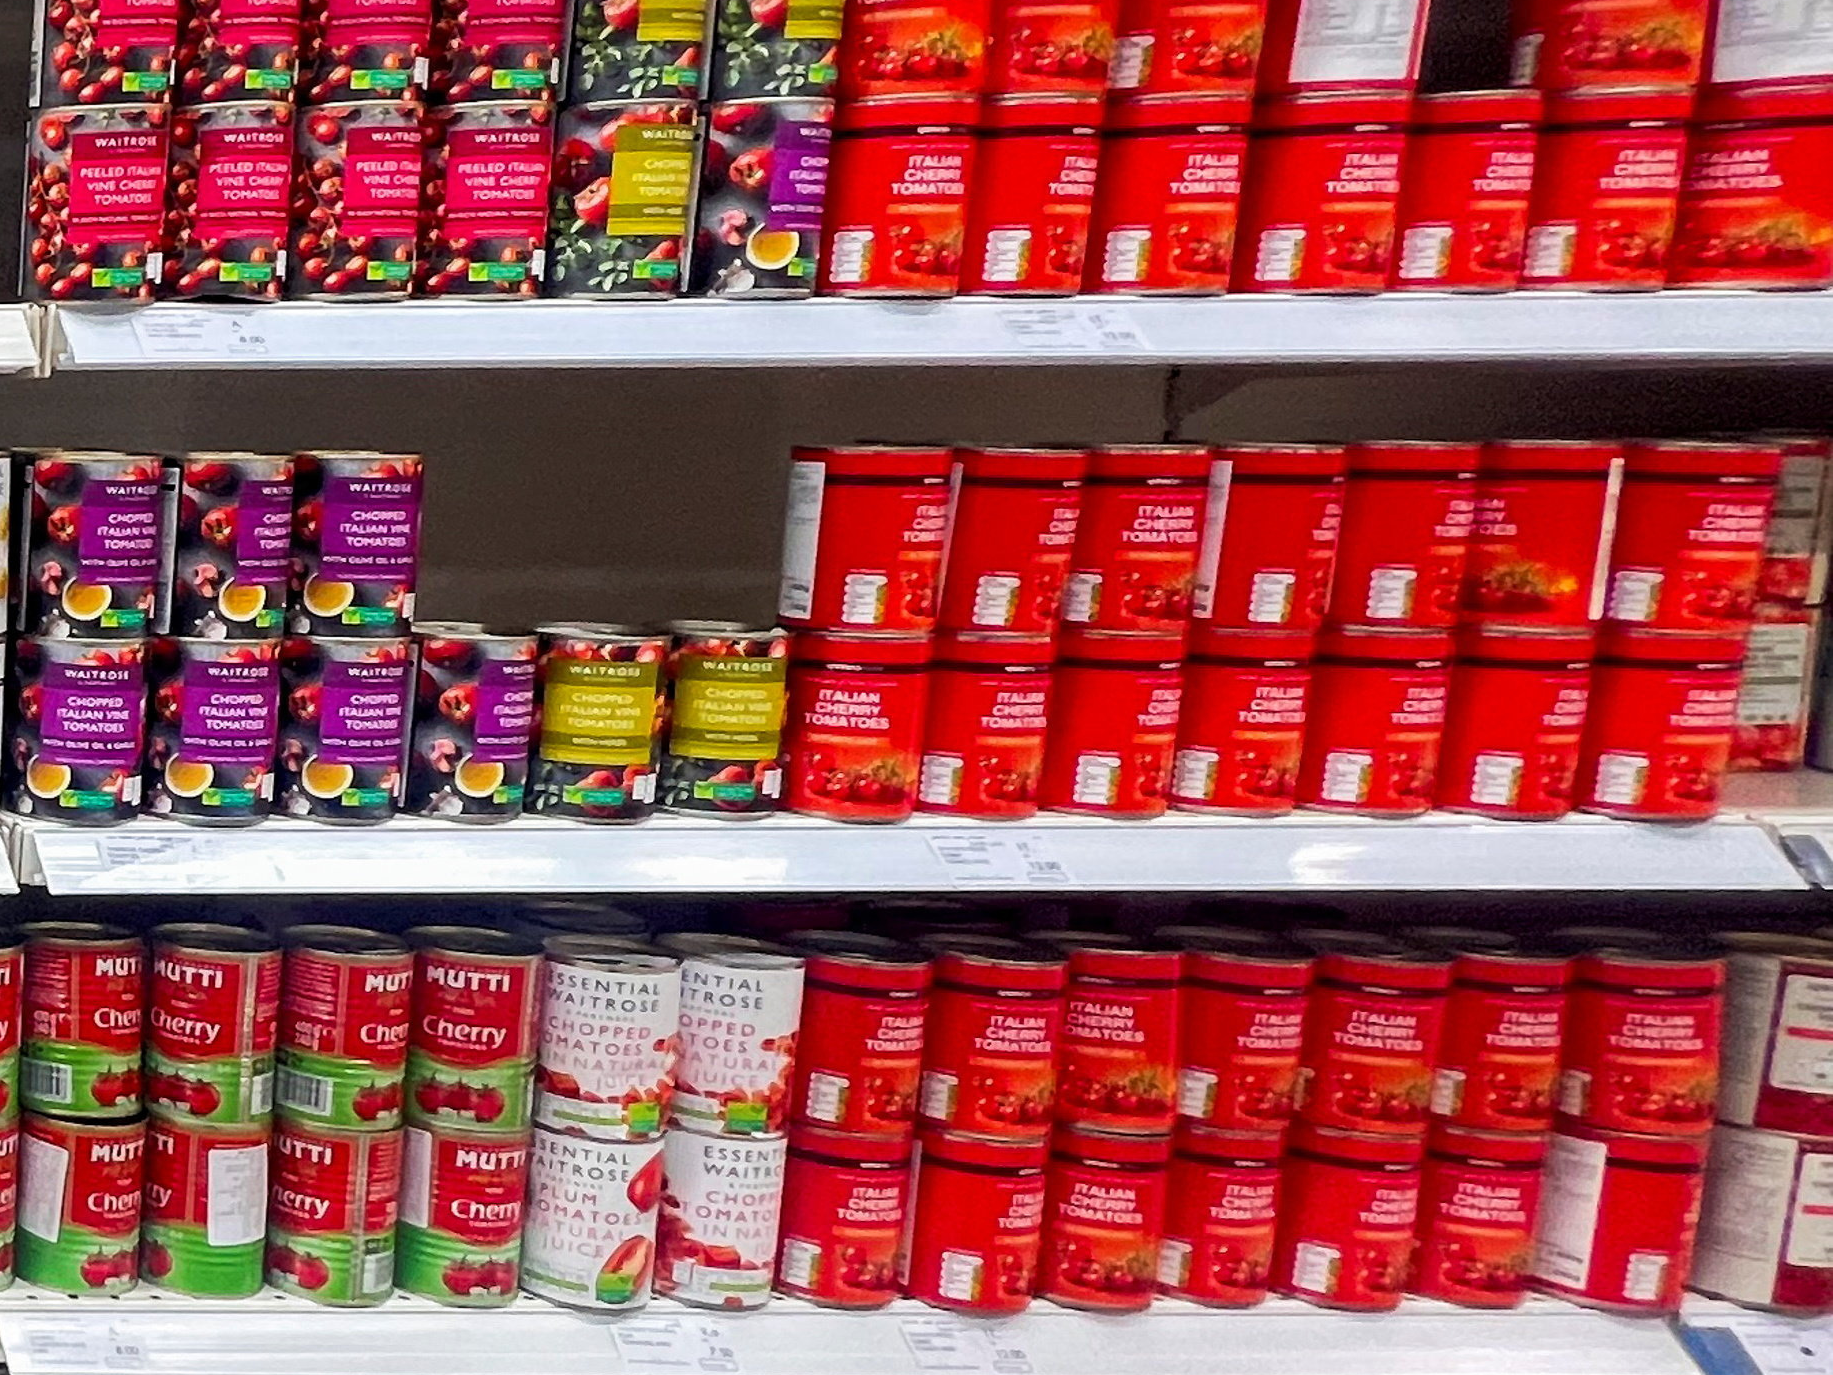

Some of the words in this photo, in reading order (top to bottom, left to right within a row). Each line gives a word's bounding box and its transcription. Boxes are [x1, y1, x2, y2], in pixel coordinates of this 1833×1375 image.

[426, 964, 511, 994] MUTTI
[548, 988, 659, 1013] WAITROSE
[422, 1015, 507, 1048] Cherry
[549, 1015, 652, 1040] CHOPPED
[540, 1182, 598, 1207] PLUM
